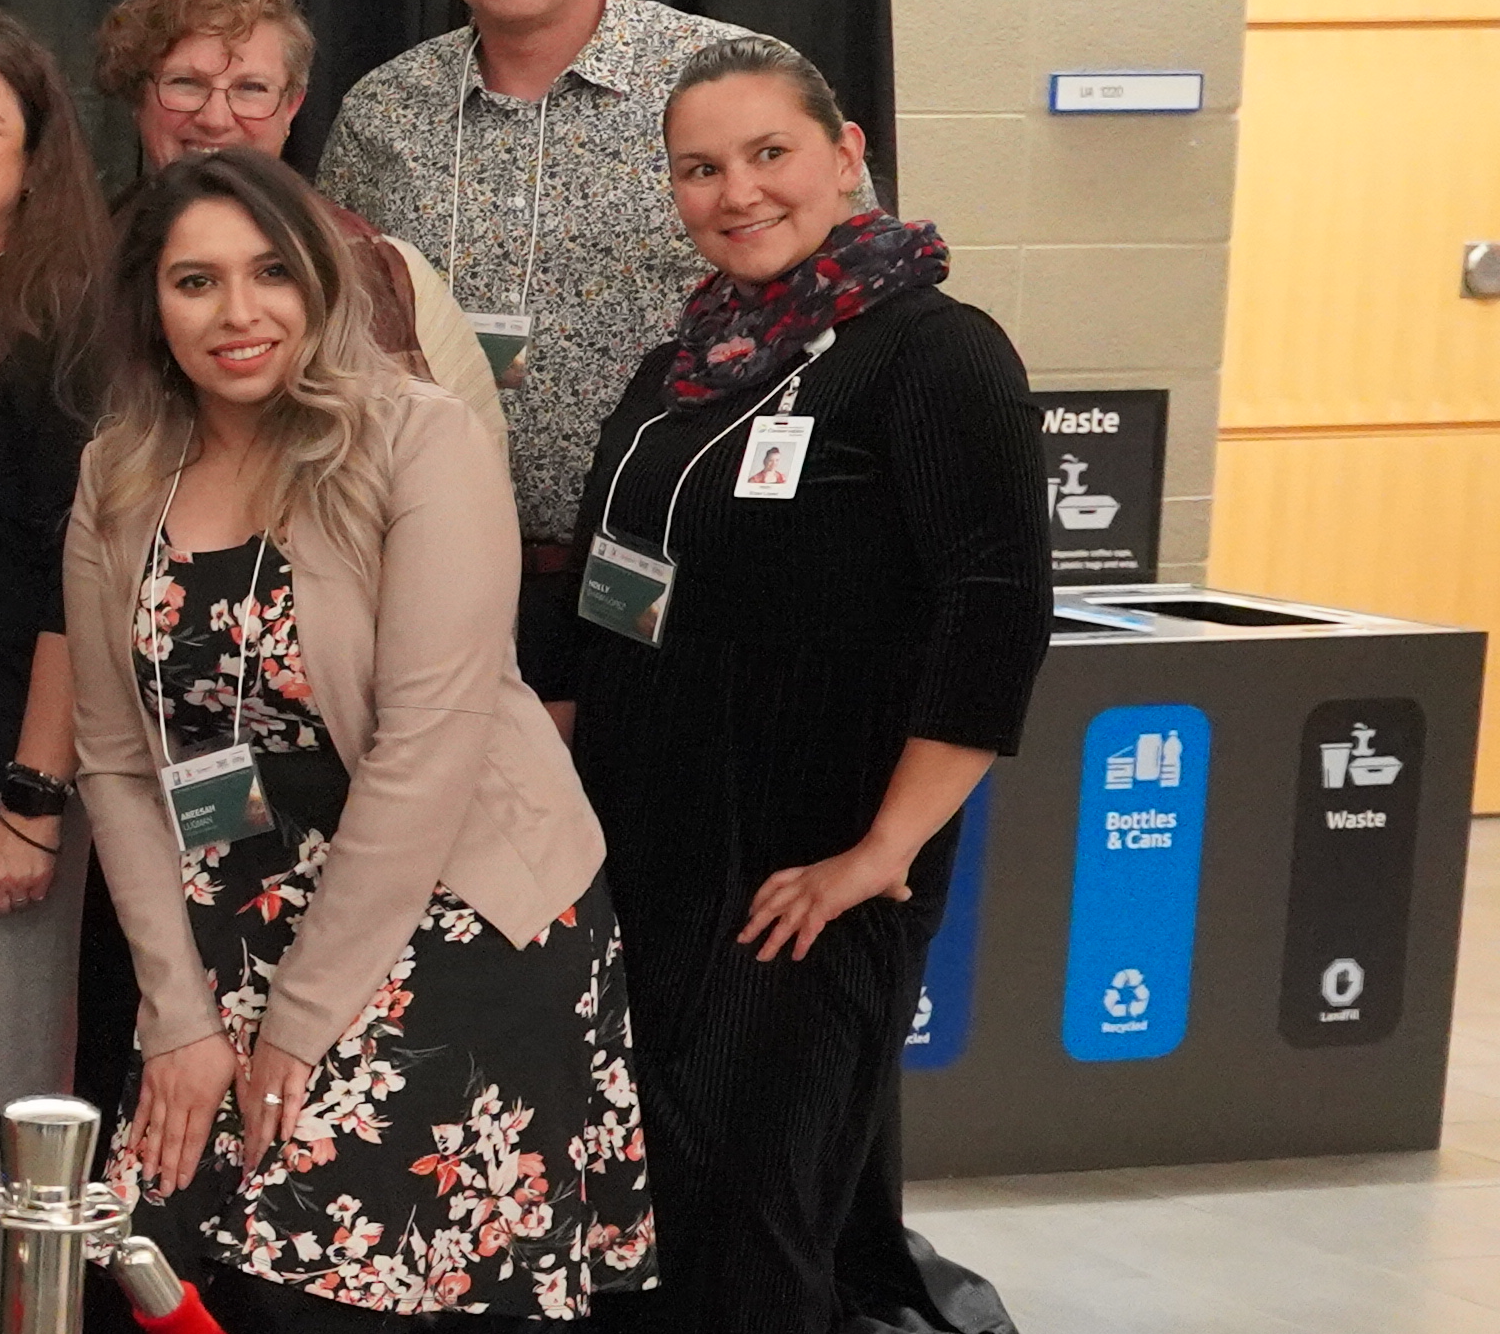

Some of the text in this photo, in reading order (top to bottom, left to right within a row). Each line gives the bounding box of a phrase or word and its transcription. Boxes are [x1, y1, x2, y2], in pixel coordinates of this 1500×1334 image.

[1041, 407, 1120, 434] Waste
[1105, 810, 1177, 831] Bottles
[1326, 809, 1386, 830] Waste
[1106, 829, 1172, 851] & Cans
